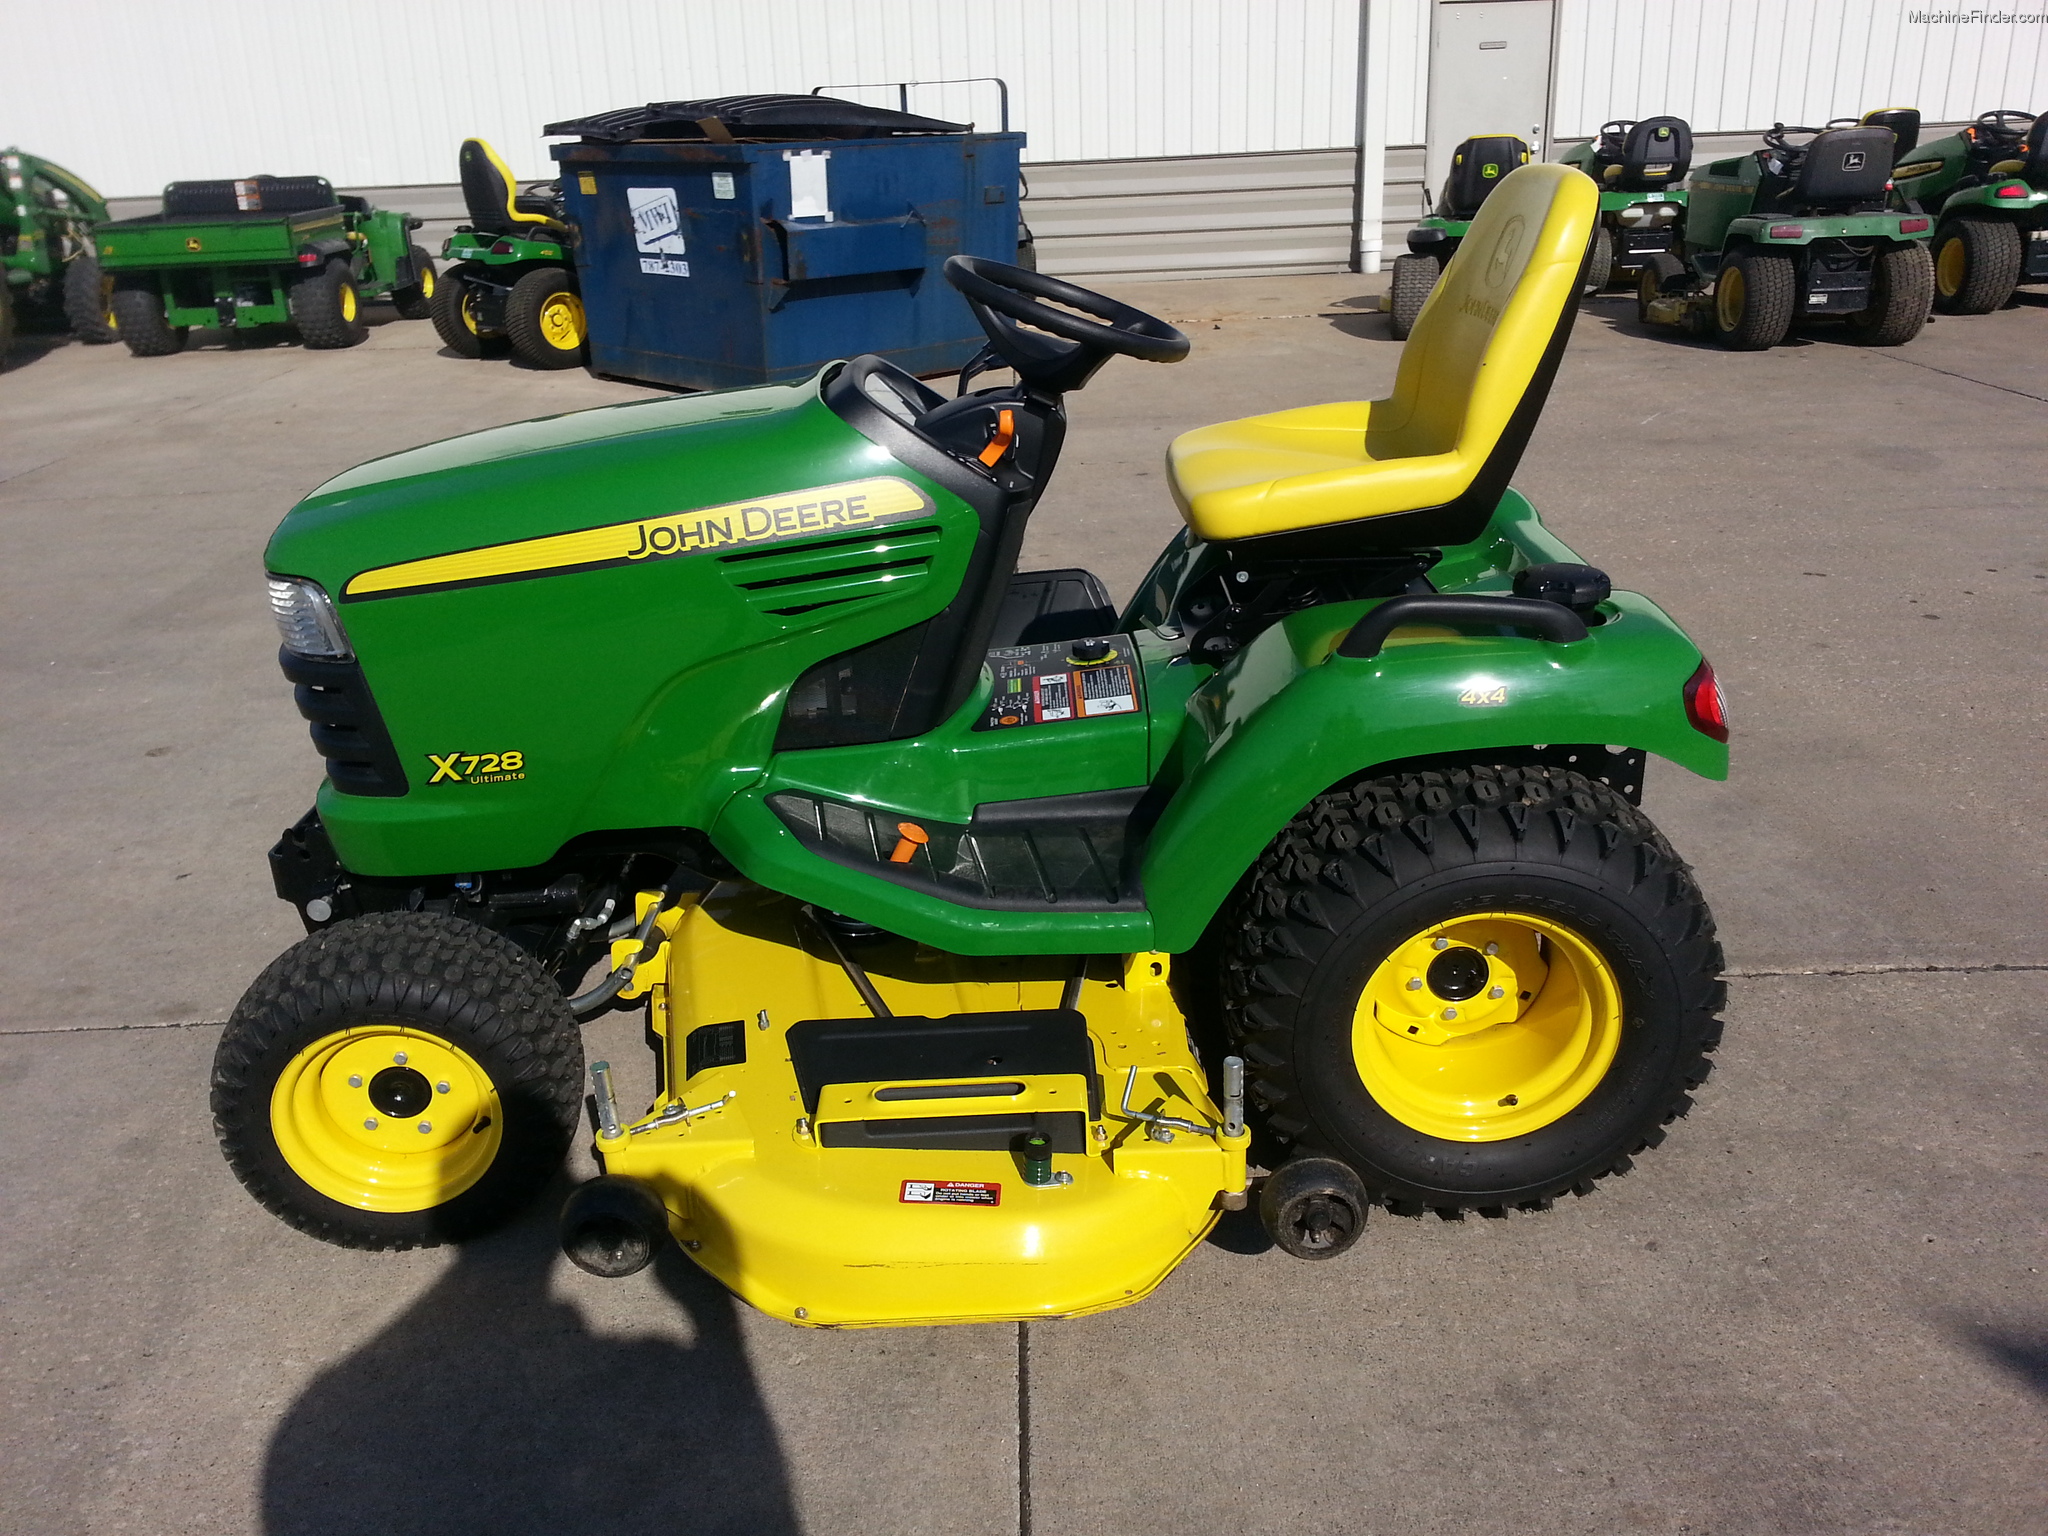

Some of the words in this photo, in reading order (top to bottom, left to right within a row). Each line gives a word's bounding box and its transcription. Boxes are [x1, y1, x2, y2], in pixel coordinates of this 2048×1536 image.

[627, 516, 732, 556] JOHN
[741, 495, 870, 538] DEERE
[1460, 686, 1507, 705] 4x4
[426, 750, 525, 785] X728
[470, 772, 526, 785] Ultimate
